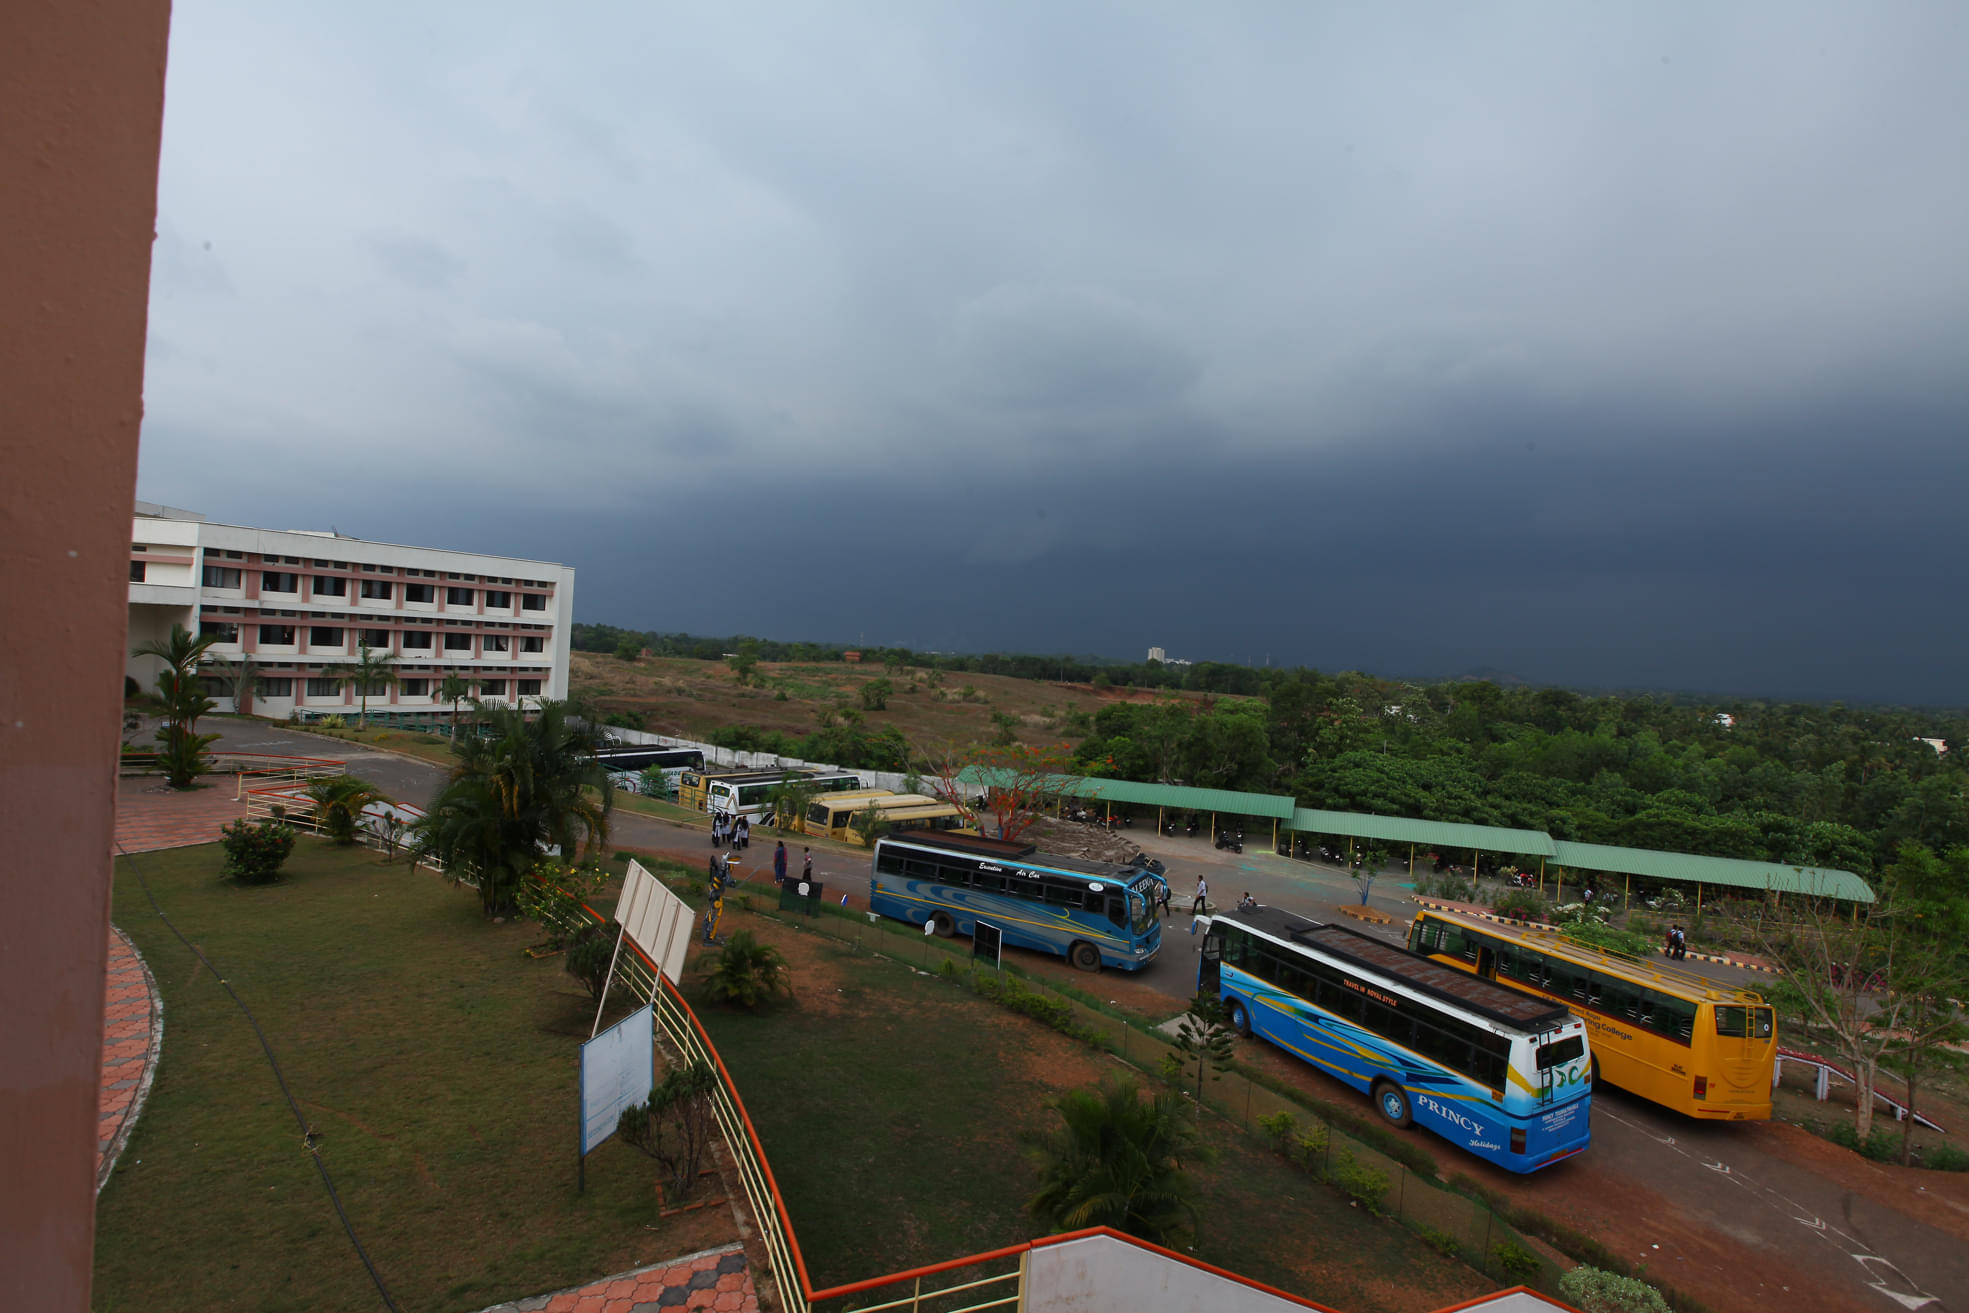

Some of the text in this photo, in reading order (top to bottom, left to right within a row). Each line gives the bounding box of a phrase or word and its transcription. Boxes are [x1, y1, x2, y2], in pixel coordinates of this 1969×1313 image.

[1601, 1023, 1633, 1040] College
[1418, 1095, 1485, 1137] PRINCY
[1468, 1139, 1501, 1152] Holidays
